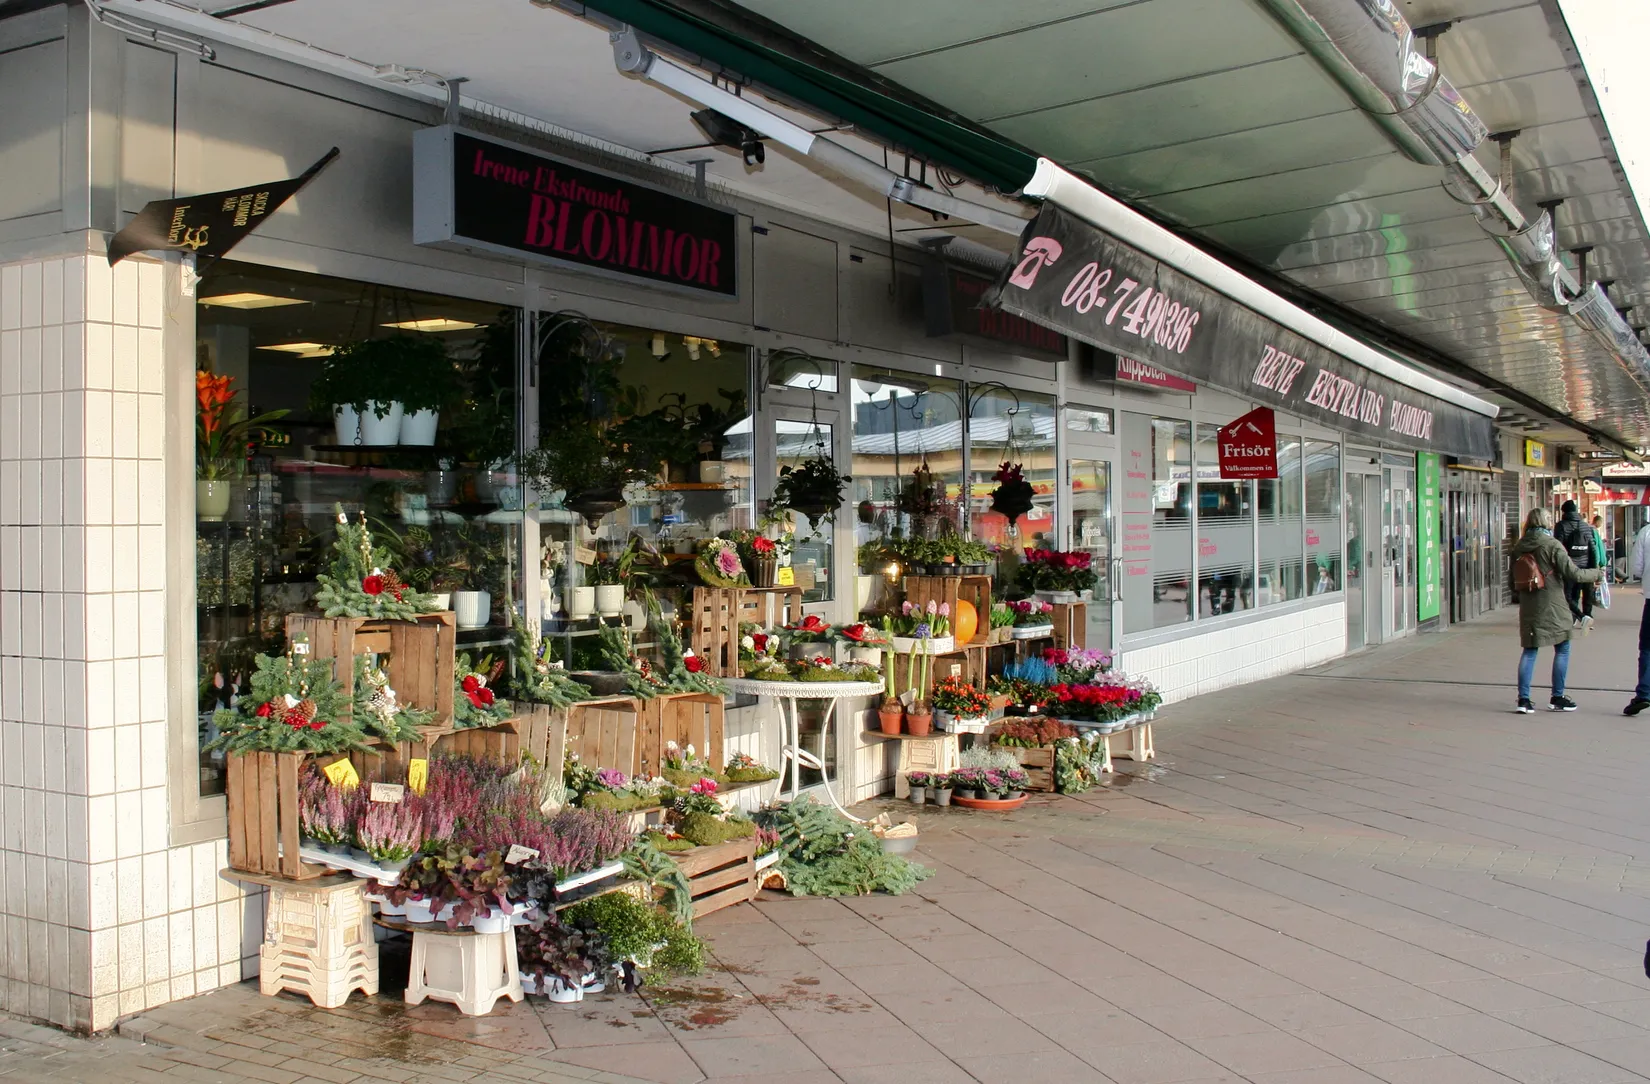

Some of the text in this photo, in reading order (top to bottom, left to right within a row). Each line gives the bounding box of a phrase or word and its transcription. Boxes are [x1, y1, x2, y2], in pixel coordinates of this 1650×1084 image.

[472, 149, 632, 215] Irene Ekstrands
[167, 204, 191, 244] Interflora
[232, 193, 254, 228] BLOMMOR
[523, 193, 721, 287] BLOMMOR
[1223, 442, 1272, 459] Frisör
[1224, 463, 1273, 473] Välkommen in
